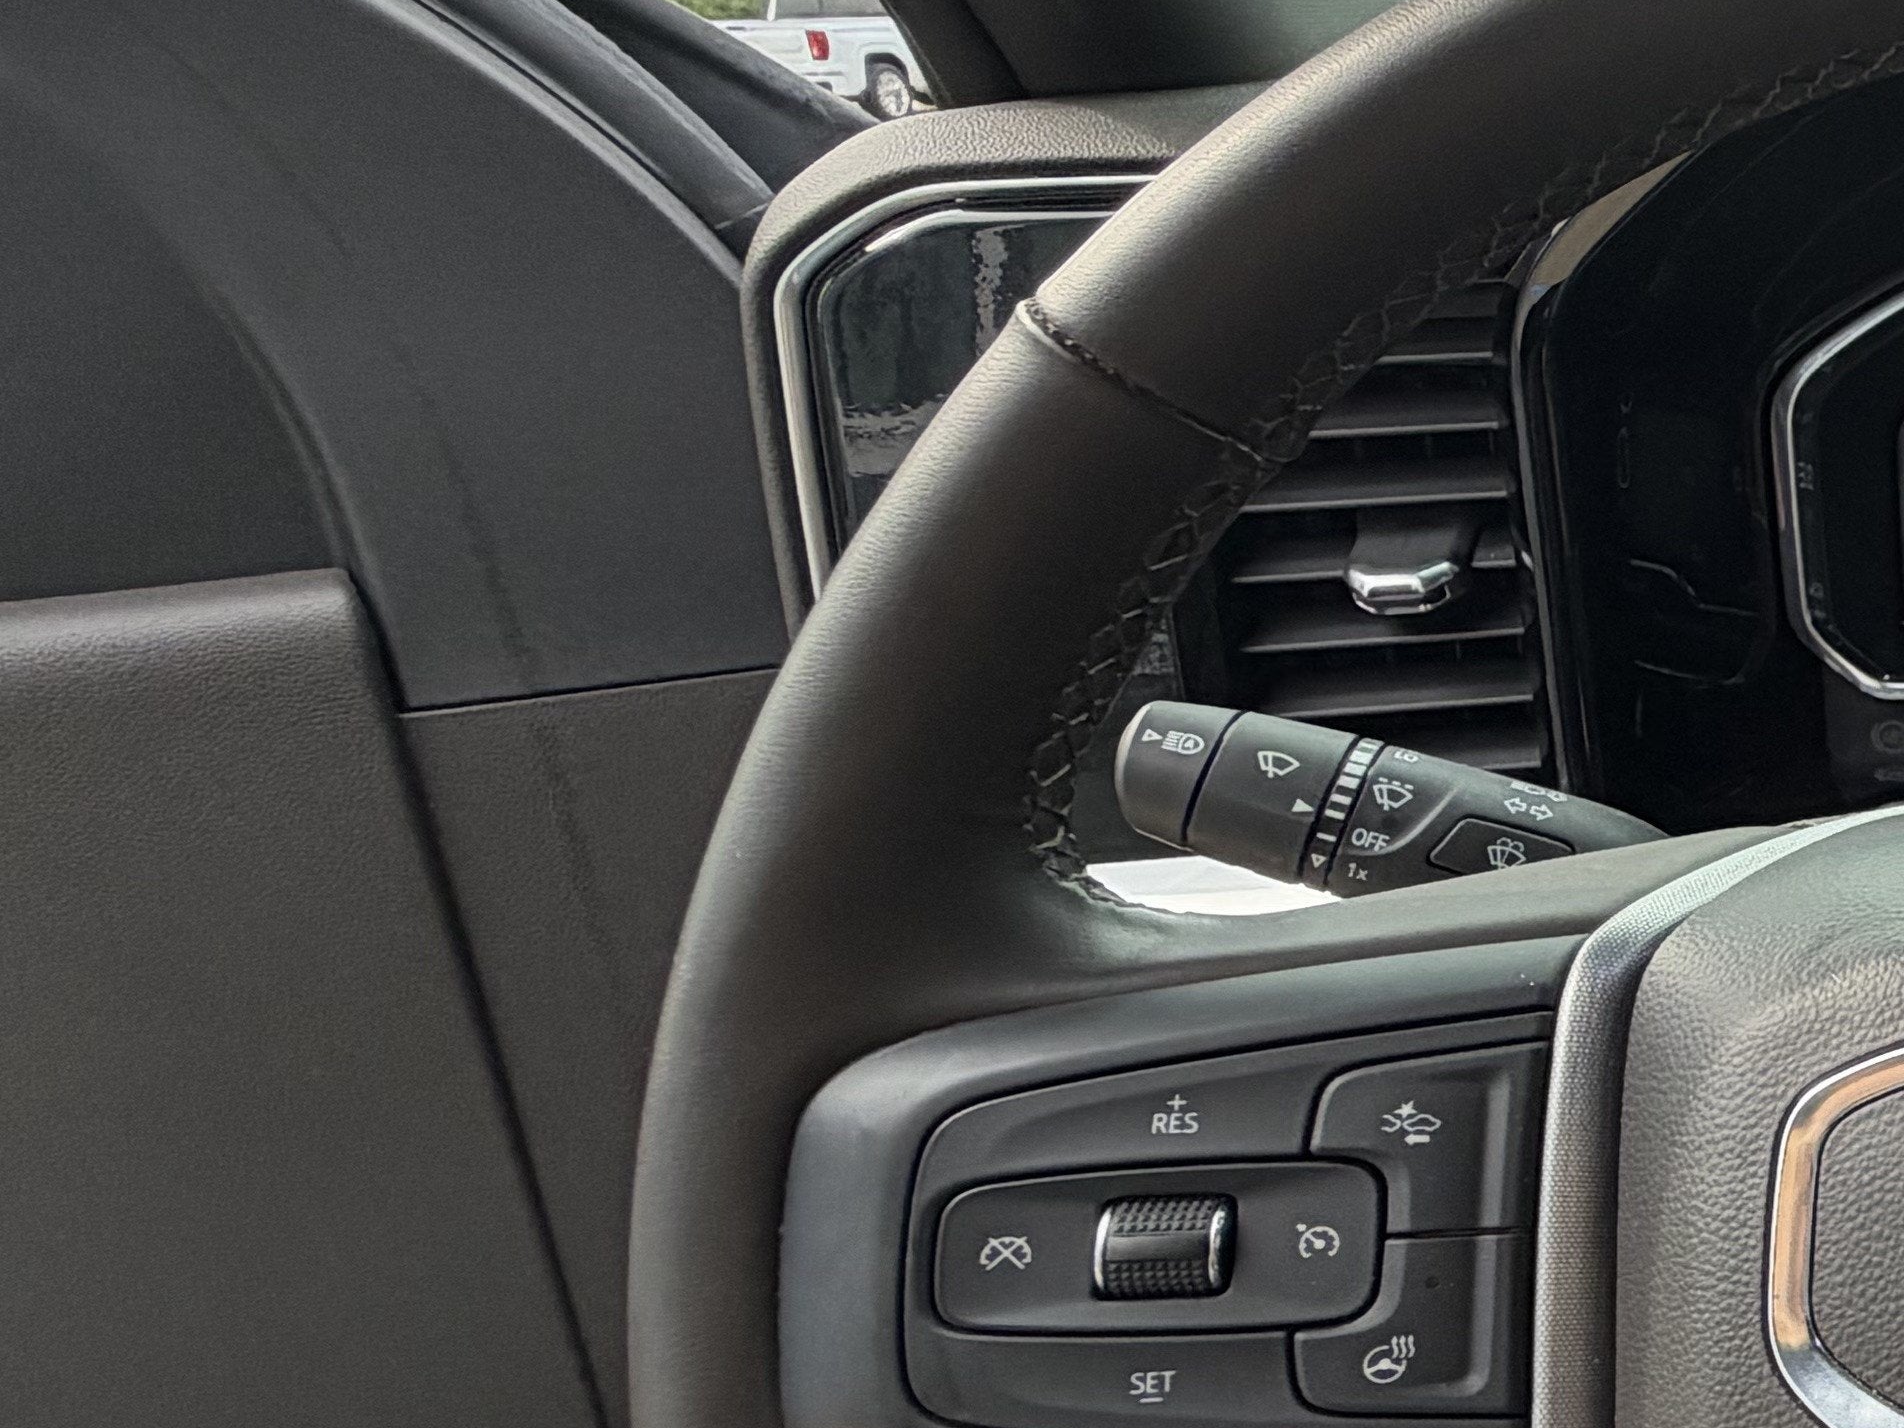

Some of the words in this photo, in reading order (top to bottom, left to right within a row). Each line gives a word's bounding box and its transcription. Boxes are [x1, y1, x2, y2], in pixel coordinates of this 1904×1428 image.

[1350, 826, 1392, 853] OFF
[1347, 861, 1369, 881] 1x
[1150, 1110, 1200, 1136] RES
[1128, 1369, 1176, 1396] SET
